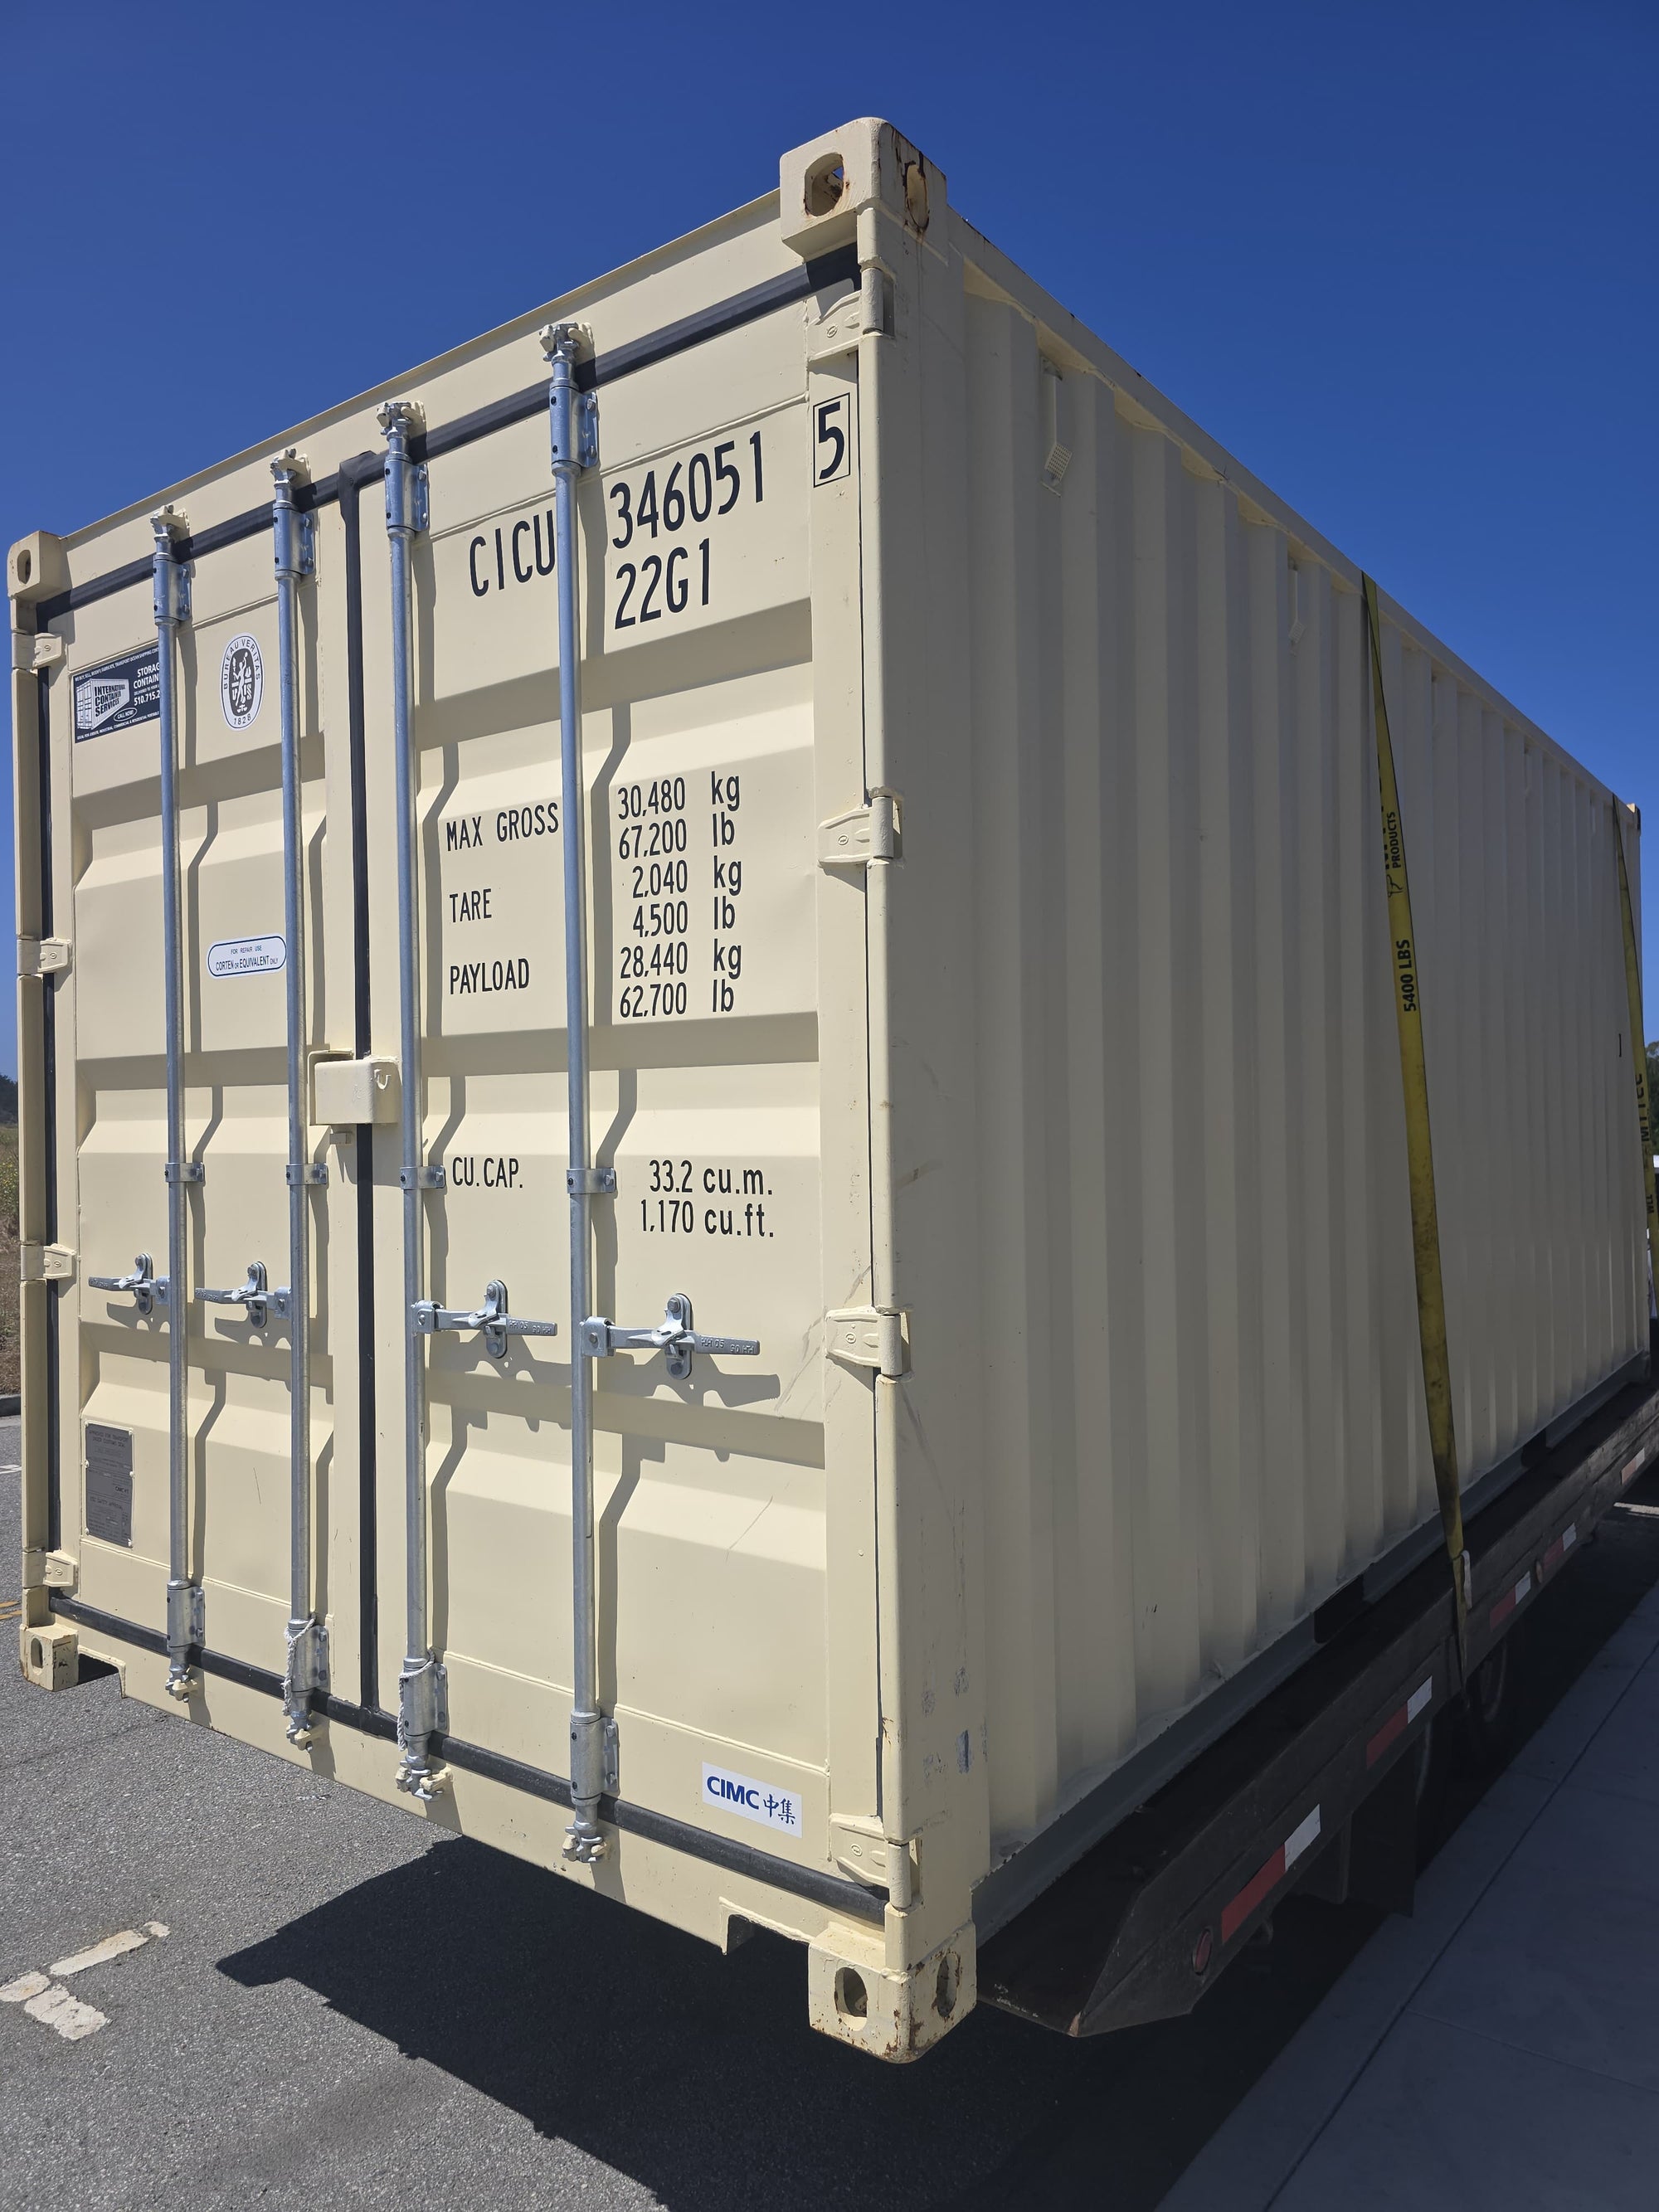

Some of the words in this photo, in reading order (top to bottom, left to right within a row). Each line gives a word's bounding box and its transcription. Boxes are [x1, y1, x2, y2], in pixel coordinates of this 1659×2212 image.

[470, 510, 555, 596] CICU
[611, 431, 763, 549] 346051
[819, 401, 844, 479] 5
[615, 538, 710, 630] 22G1
[223, 641, 239, 690] BUREAU
[241, 639, 261, 680] VERITAS
[94, 684, 125, 697] INTERNATIONAL
[95, 690, 121, 707] CONTAINER
[95, 698, 119, 717] SERVICES
[233, 713, 251, 725] 1828
[446, 816, 484, 852] MAX
[496, 802, 559, 843] GROSS
[617, 776, 686, 820] 30,480
[711, 771, 740, 811] kg
[619, 819, 687, 859] 67,200
[713, 812, 735, 847] lb
[1387, 811, 1401, 868] PRODUCTS
[450, 888, 492, 923] TARE
[632, 859, 688, 899] 2,040
[713, 855, 742, 896] kg
[633, 901, 688, 939] 4,500
[713, 896, 736, 930] lb
[216, 960, 234, 971] CORTEN
[239, 955, 270, 969] EQUIVALENT
[450, 959, 530, 994] PAYLOAD
[620, 941, 688, 980] 28,440
[713, 938, 742, 980] kg
[1396, 939, 1411, 969] LBS
[620, 982, 687, 1018] 62,700
[713, 979, 734, 1013] lb
[1400, 974, 1417, 1012] 5400
[649, 1159, 693, 1193] 33.2
[703, 1168, 772, 1195] cu.m.
[640, 1198, 694, 1233] 1,170
[704, 1203, 774, 1237] cu.ft.
[707, 1776, 759, 1810] CIMC
[763, 1793, 795, 1825] 中集
